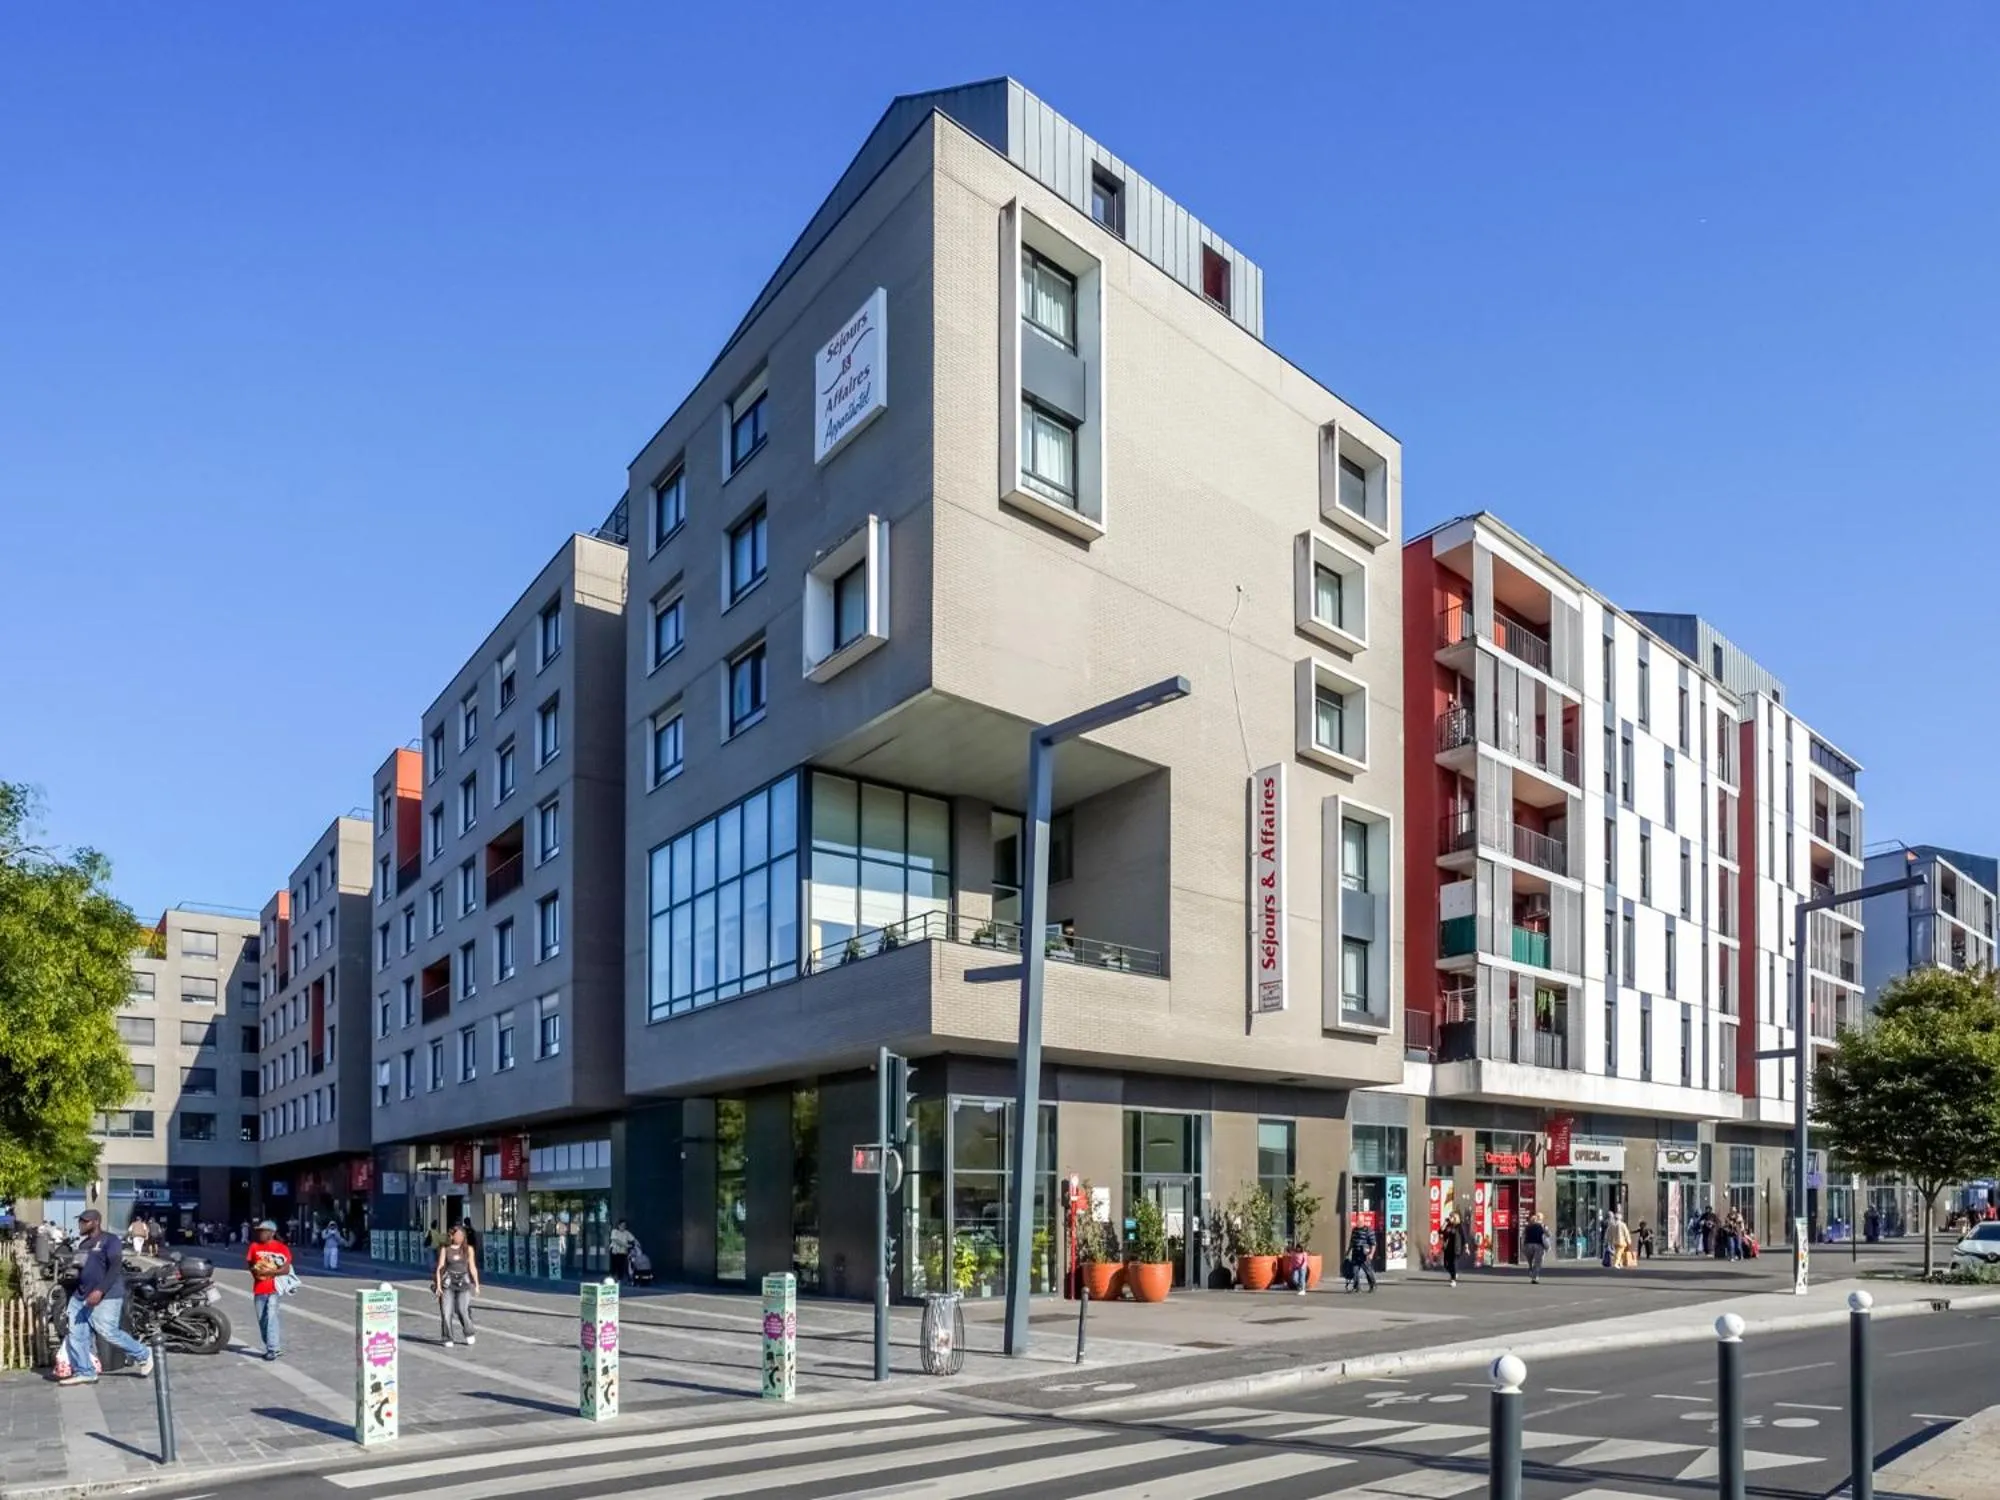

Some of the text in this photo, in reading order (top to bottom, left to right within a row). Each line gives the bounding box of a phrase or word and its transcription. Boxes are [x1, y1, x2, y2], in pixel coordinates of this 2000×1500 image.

[826, 311, 868, 364] Séjours
[825, 363, 871, 418] Affaires
[1261, 777, 1276, 862] Affaires
[1261, 870, 1276, 889] &
[1261, 894, 1282, 971] Séjours
